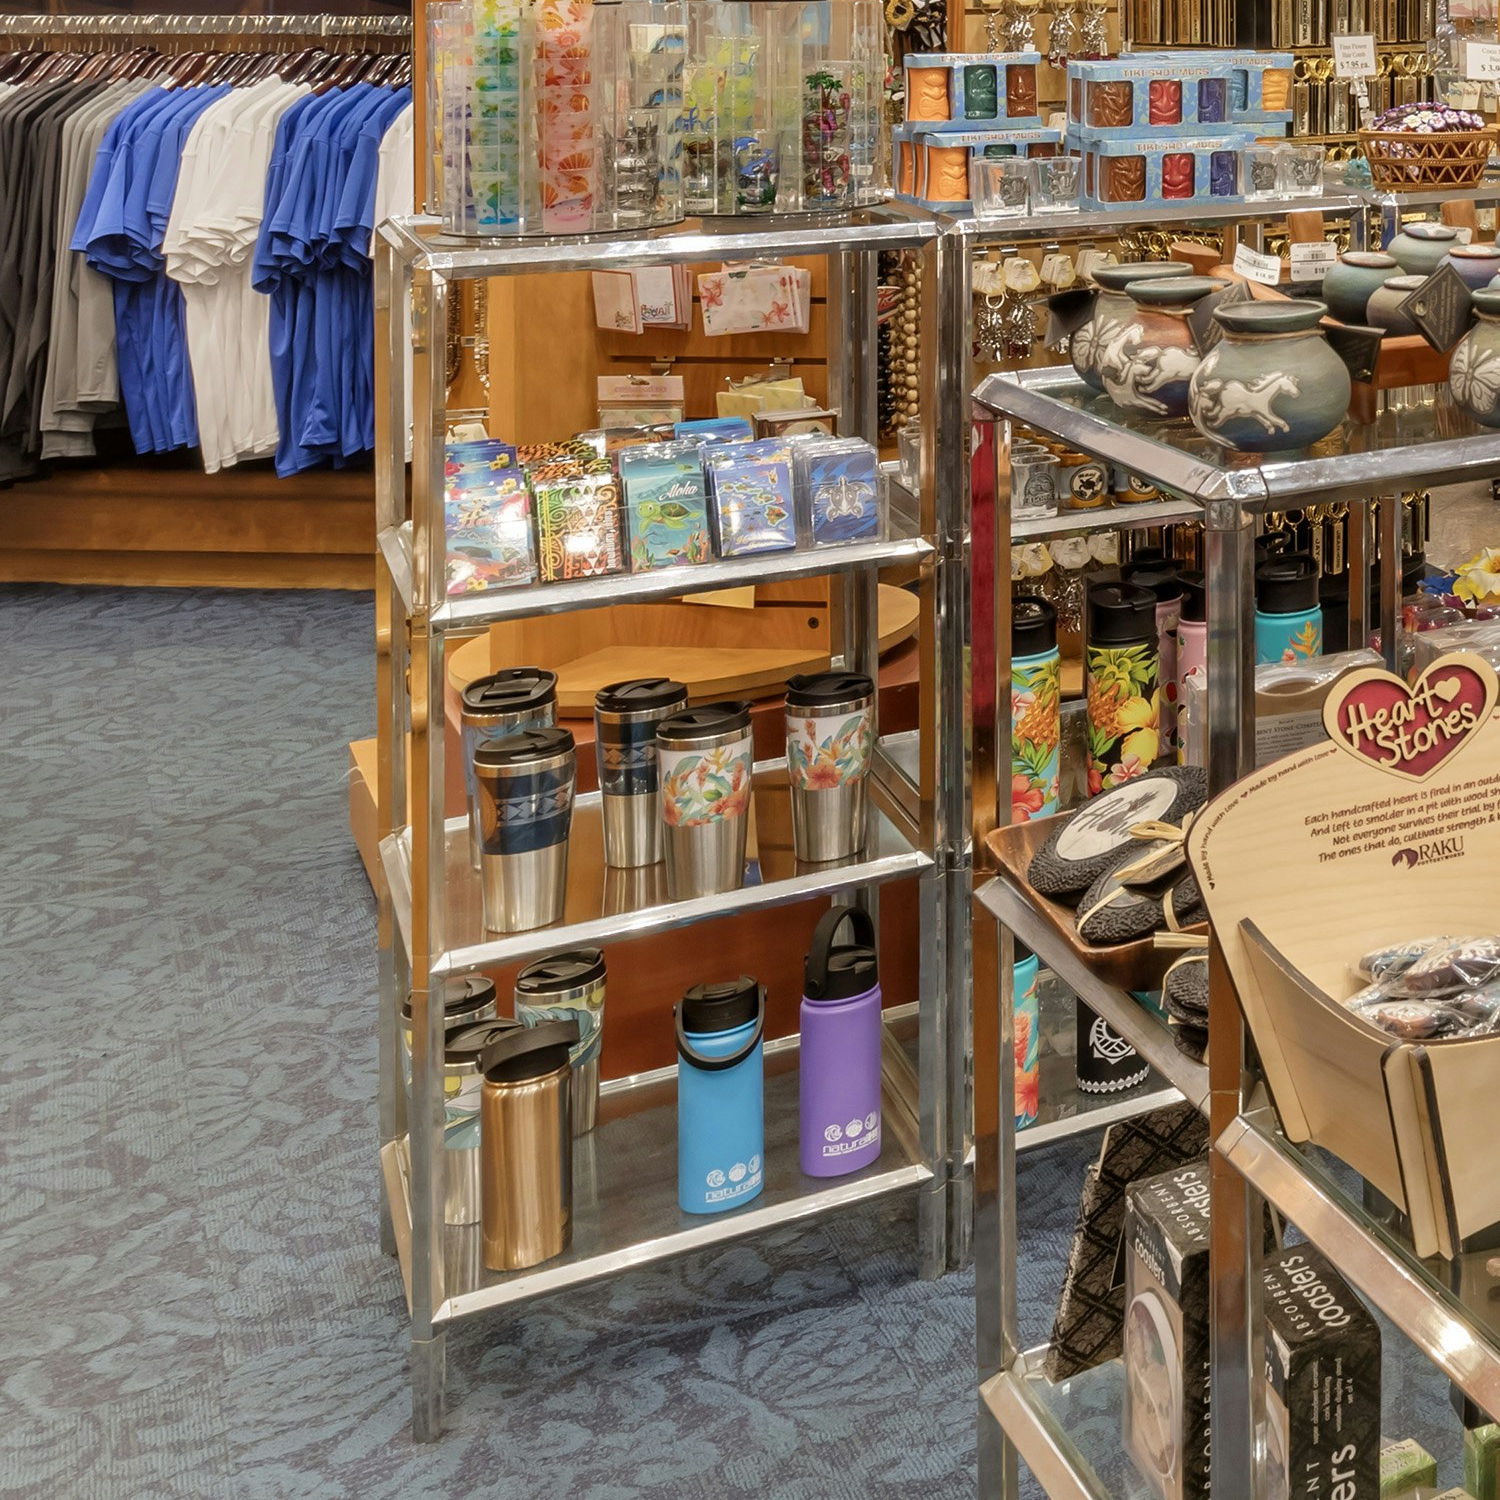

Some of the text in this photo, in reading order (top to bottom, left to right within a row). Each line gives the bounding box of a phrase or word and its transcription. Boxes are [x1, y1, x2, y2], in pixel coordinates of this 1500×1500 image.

[1123, 69, 1143, 77] TIKI
[658, 482, 699, 501] Aloha
[1346, 676, 1443, 750] Heart
[1377, 702, 1478, 768] Stones
[1304, 814, 1329, 826] Each
[1331, 799, 1391, 820] handcrafted
[1393, 792, 1418, 806] heart
[1421, 790, 1427, 799] is
[1430, 784, 1450, 798] fired
[1452, 783, 1461, 792] in
[1463, 780, 1476, 790] an
[1310, 825, 1331, 838] And
[1333, 820, 1351, 833] left
[1353, 818, 1364, 828] to
[1366, 808, 1404, 825] smolder
[1406, 806, 1416, 816] in
[1418, 805, 1424, 813] a
[1426, 800, 1439, 814] pit
[1440, 795, 1462, 808] with
[1464, 789, 1488, 804] wood
[1332, 835, 1351, 846] Not
[1352, 825, 1396, 842] everyone
[1398, 816, 1435, 831] survives
[1437, 809, 1459, 822] their
[1461, 804, 1481, 817] trial
[1483, 802, 1495, 815] by
[1318, 851, 1336, 864] The
[1339, 846, 1362, 859] ones
[1363, 839, 1386, 852] that
[1387, 836, 1402, 847] do,
[1404, 825, 1444, 843] cultivate
[1446, 815, 1486, 833] strength
[1488, 813, 1496, 823] &
[1418, 836, 1465, 860] RAKU
[1151, 1183, 1207, 1242] ABSORBENT
[1133, 1238, 1166, 1287] coasters
[1280, 1255, 1350, 1327] coasters
